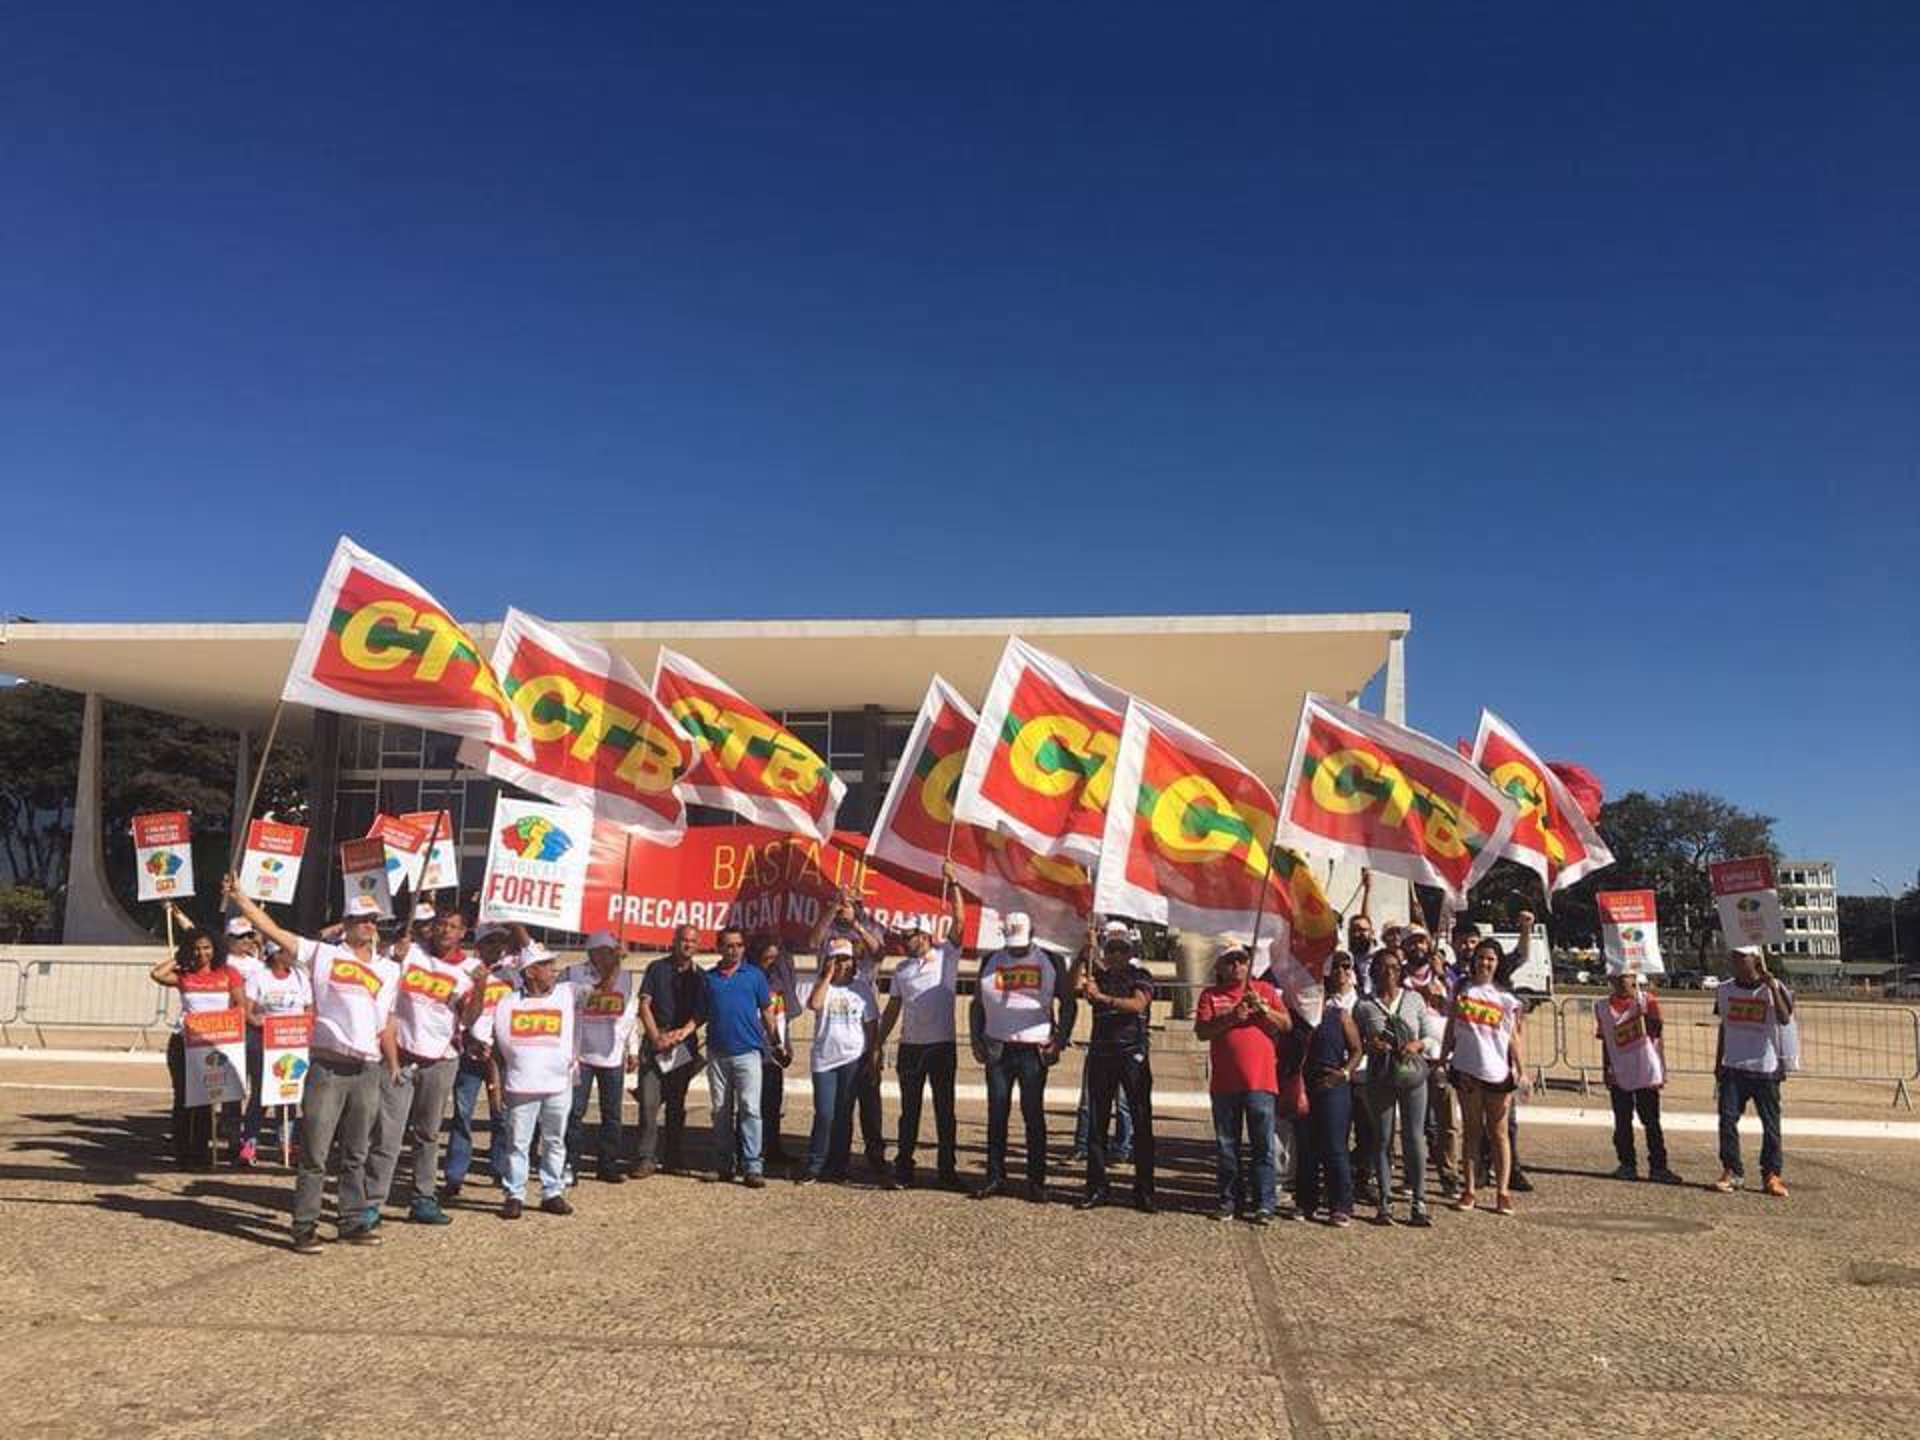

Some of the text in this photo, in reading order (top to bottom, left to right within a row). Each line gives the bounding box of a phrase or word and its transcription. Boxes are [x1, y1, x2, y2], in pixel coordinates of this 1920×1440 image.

[512, 675, 683, 795] CTB
[672, 697, 826, 796] CTB
[1010, 715, 1120, 812] CT
[1311, 749, 1480, 859] CTB
[713, 837, 823, 891] BASTA
[487, 873, 565, 911] FORTE
[786, 891, 820, 928] NO
[405, 969, 454, 998] CTB
[512, 1013, 560, 1033] CTB
